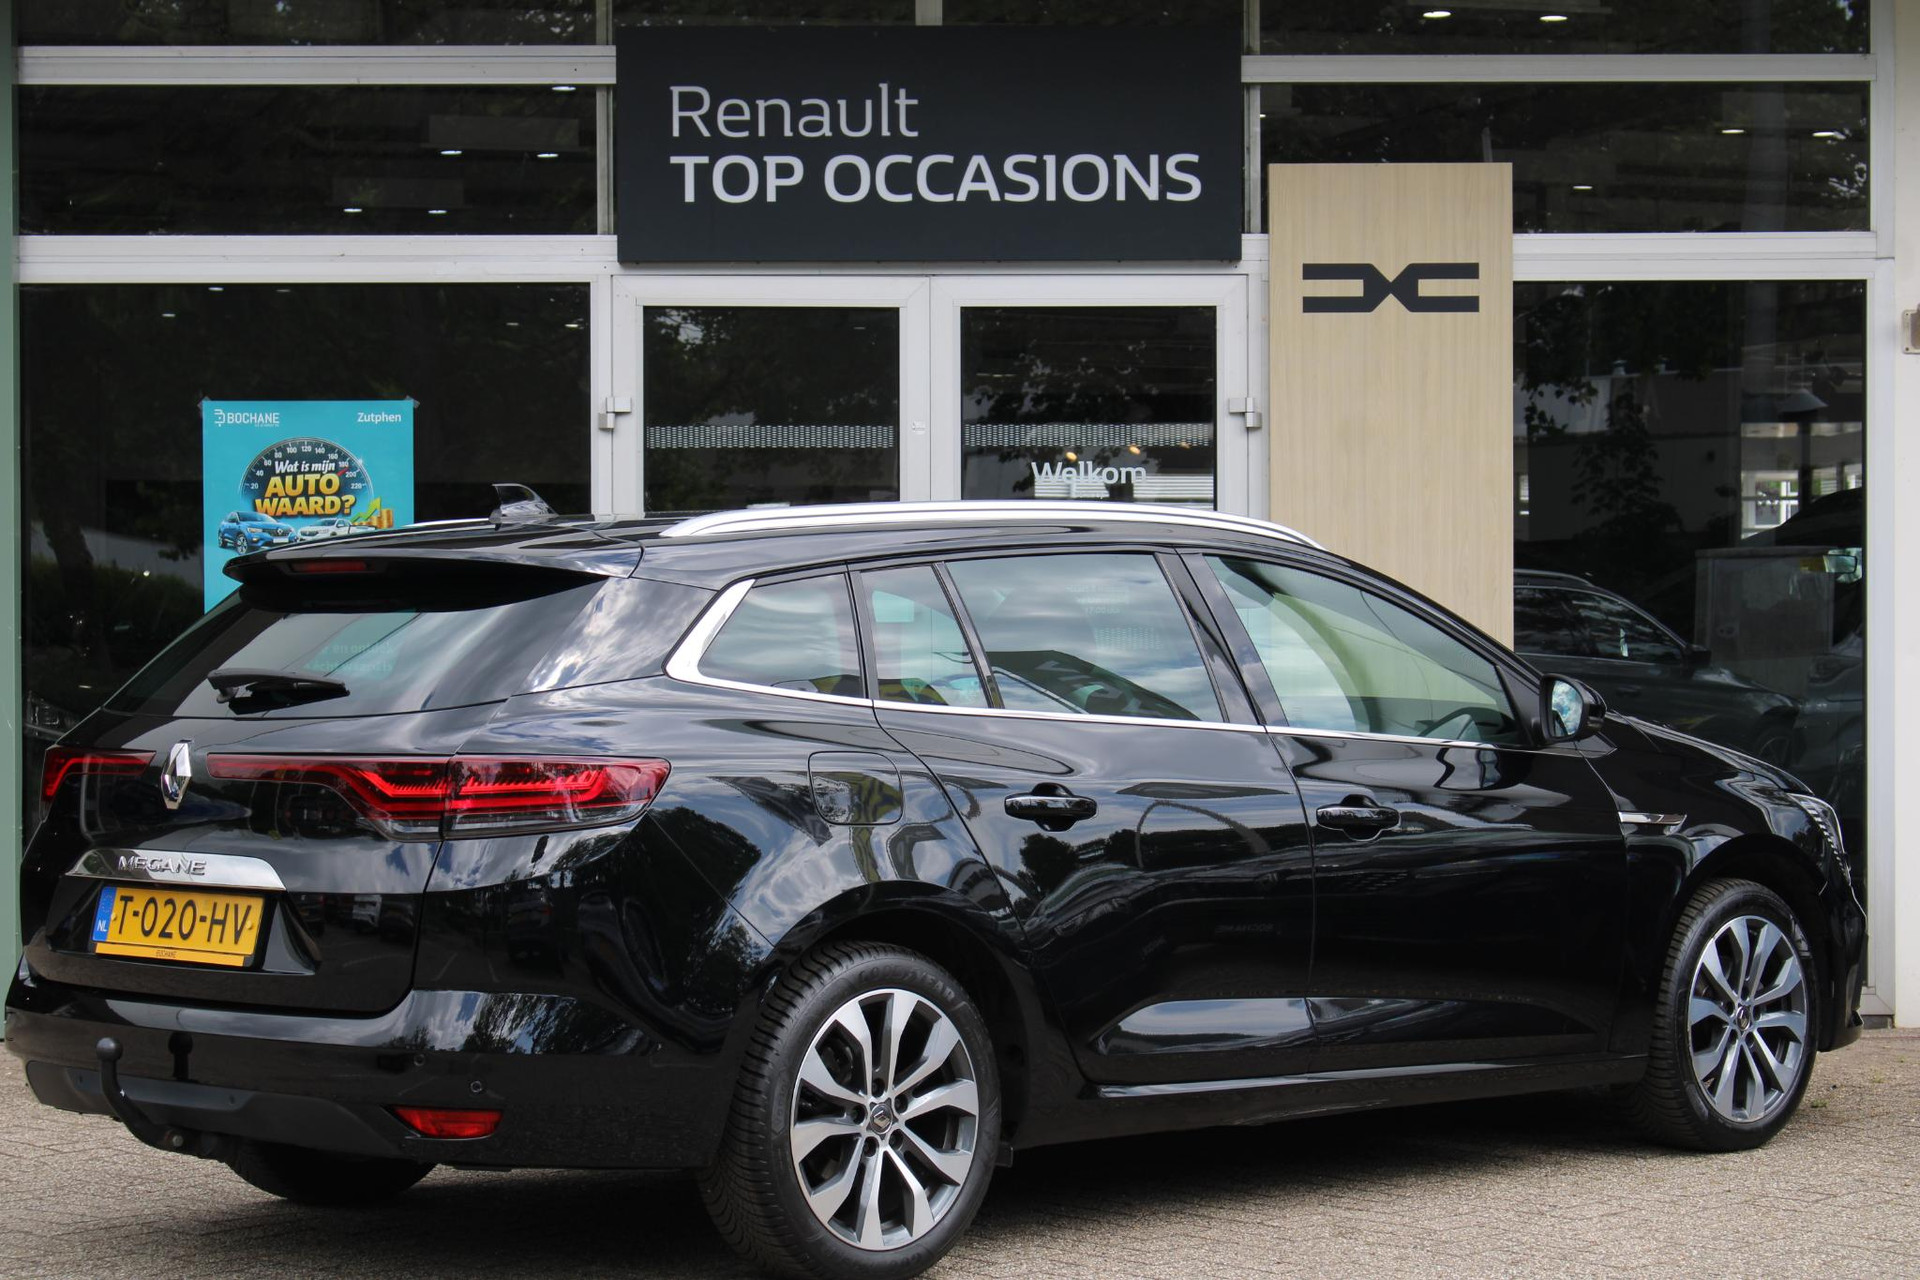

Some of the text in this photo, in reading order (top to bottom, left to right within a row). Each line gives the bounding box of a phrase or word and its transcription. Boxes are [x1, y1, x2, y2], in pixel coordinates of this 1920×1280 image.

[670, 83, 919, 137] Renault
[670, 153, 1202, 203] TOP OCCASIONS
[227, 412, 280, 424] BOCHANE
[357, 411, 402, 424] Zutphen
[274, 459, 336, 475] Wat is mijn
[1031, 460, 1147, 485] Welkom
[264, 472, 340, 498] AUTO
[255, 494, 356, 517] WAARD?
[117, 855, 206, 876] MEGANE
[97, 919, 108, 932] NL
[118, 895, 252, 944] T-020-HV
